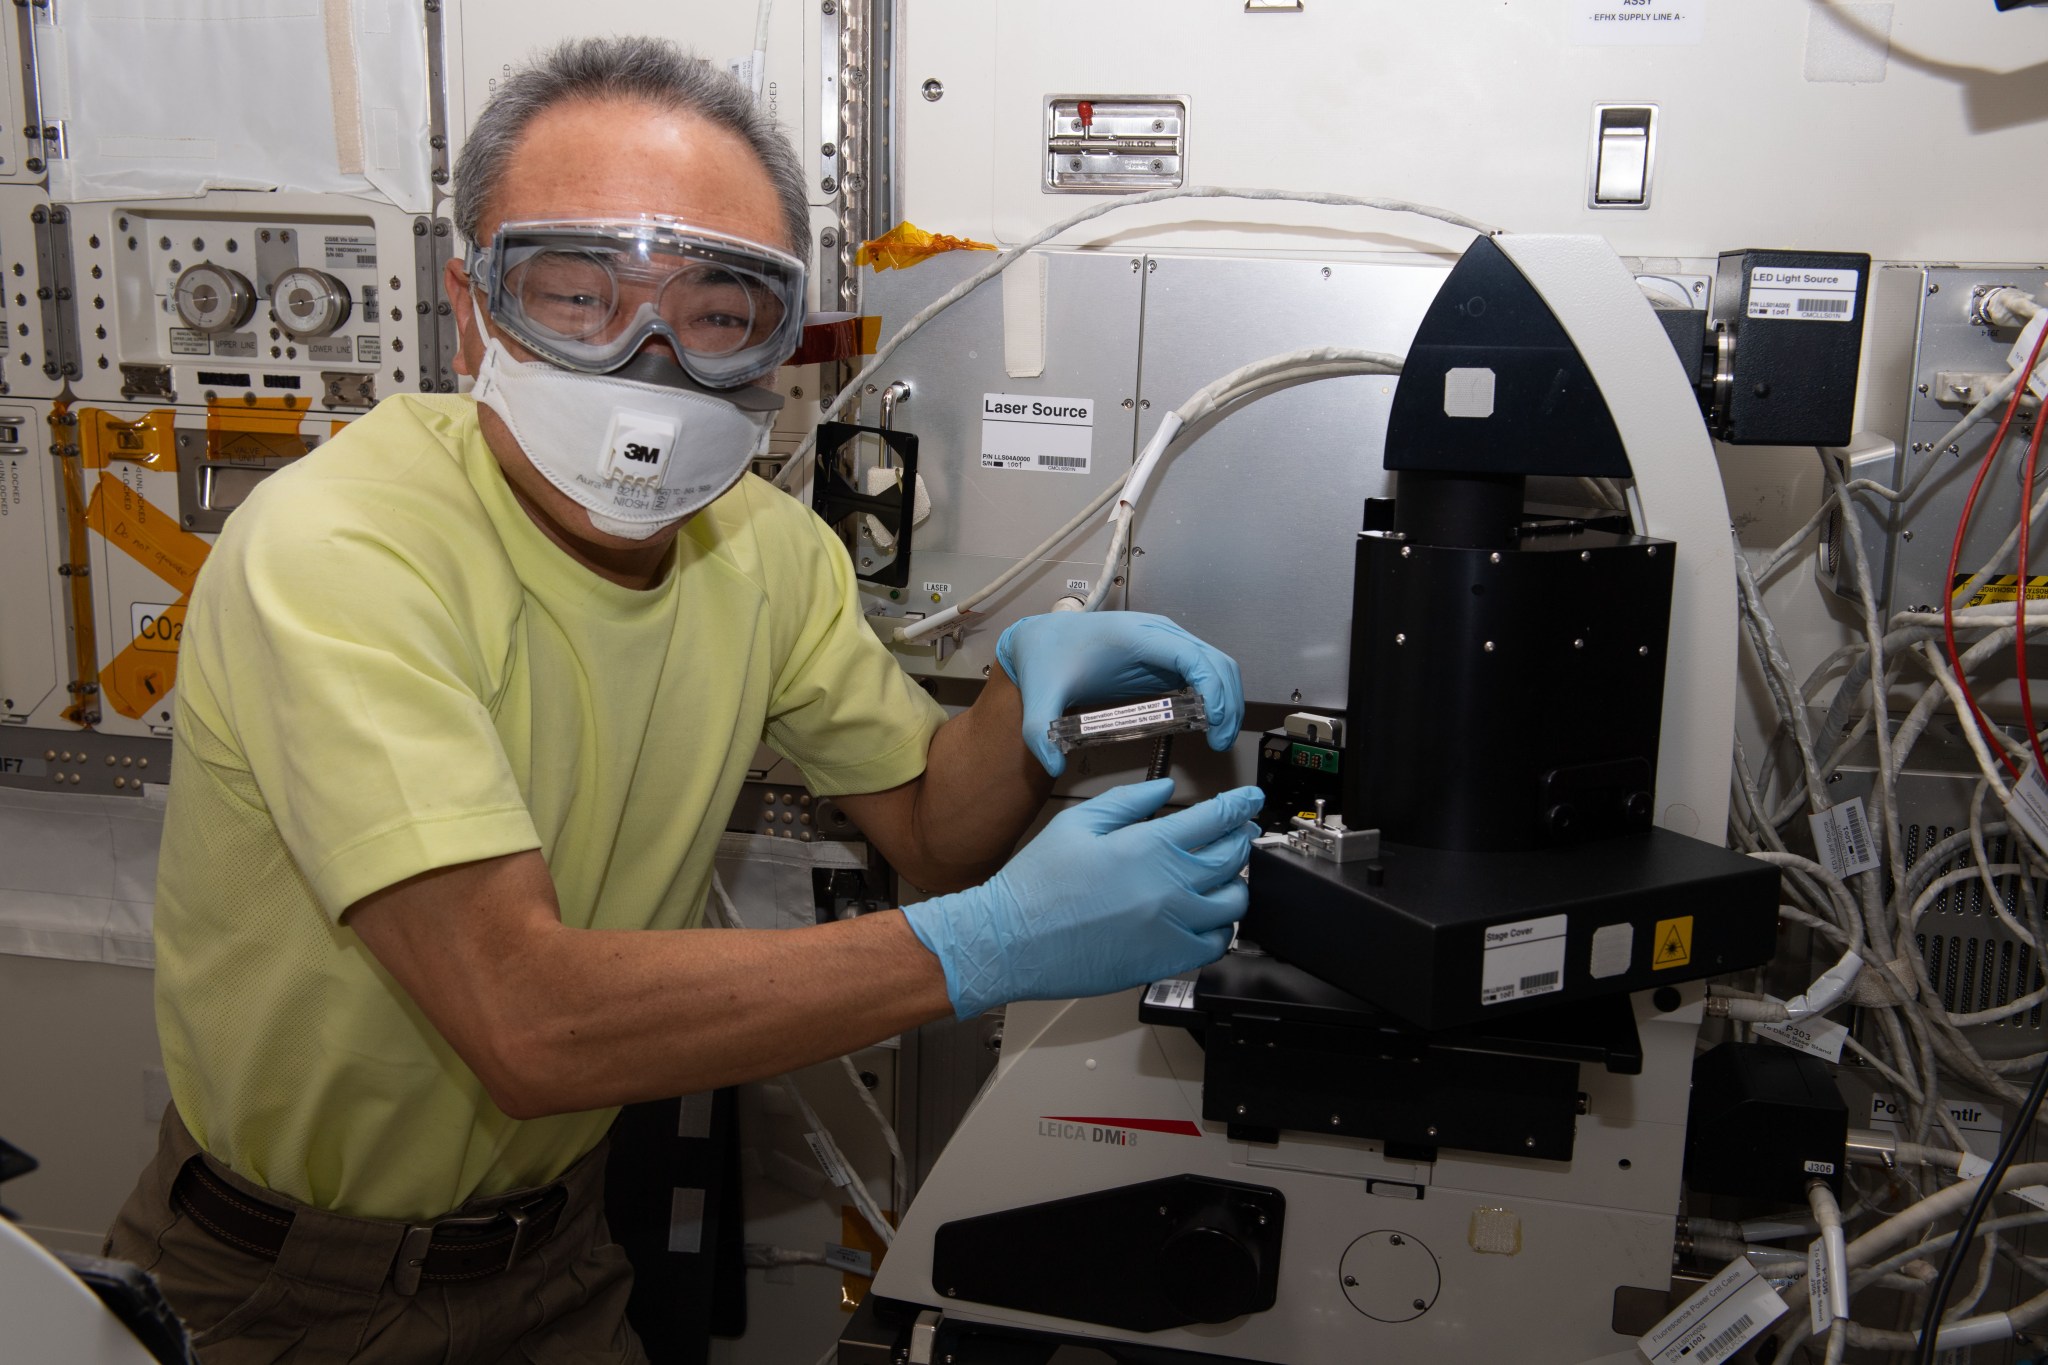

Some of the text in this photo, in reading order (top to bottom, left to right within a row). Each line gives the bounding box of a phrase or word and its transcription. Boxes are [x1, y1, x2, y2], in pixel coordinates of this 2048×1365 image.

[1594, 13, 1616, 21] EFHX
[1618, 13, 1651, 21] SUPPLY
[1653, 13, 1672, 21] LINE
[1117, 140, 1157, 148] UNLOCK
[1753, 273, 1839, 284] LED Light Source
[216, 340, 237, 349] UPPER
[309, 345, 352, 354] LOWER LINE
[985, 400, 1088, 418] Laser Source
[624, 442, 660, 464] 3M
[11, 467, 20, 504] LOCKED
[123, 472, 132, 511] LOCKED
[136, 474, 146, 524] UNLOCKED
[613, 496, 650, 510] NIOSH
[114, 521, 128, 538] Do
[133, 540, 150, 551] not
[926, 584, 948, 592] LASER
[1069, 581, 1086, 590] J201
[1083, 711, 1114, 722] Observation
[1114, 706, 1137, 716] Chamber
[1137, 704, 1147, 712] S/N
[1083, 722, 1114, 732] Observation
[1114, 718, 1138, 727] Chamber
[1486, 927, 1534, 942] Stage Cover
[1785, 1024, 1811, 1041] P303
[1791, 1035, 1809, 1046] Base
[1811, 1044, 1832, 1055] Stand
[1038, 1120, 1086, 1141] LEICA
[1808, 1162, 1832, 1173] J306
[1652, 1310, 1692, 1343] Fluorescence
[1689, 1294, 1709, 1312] Power
[1721, 1271, 1740, 1287] Cable
[1690, 1333, 1706, 1348] 1001
[1665, 1348, 1677, 1358] P/N
